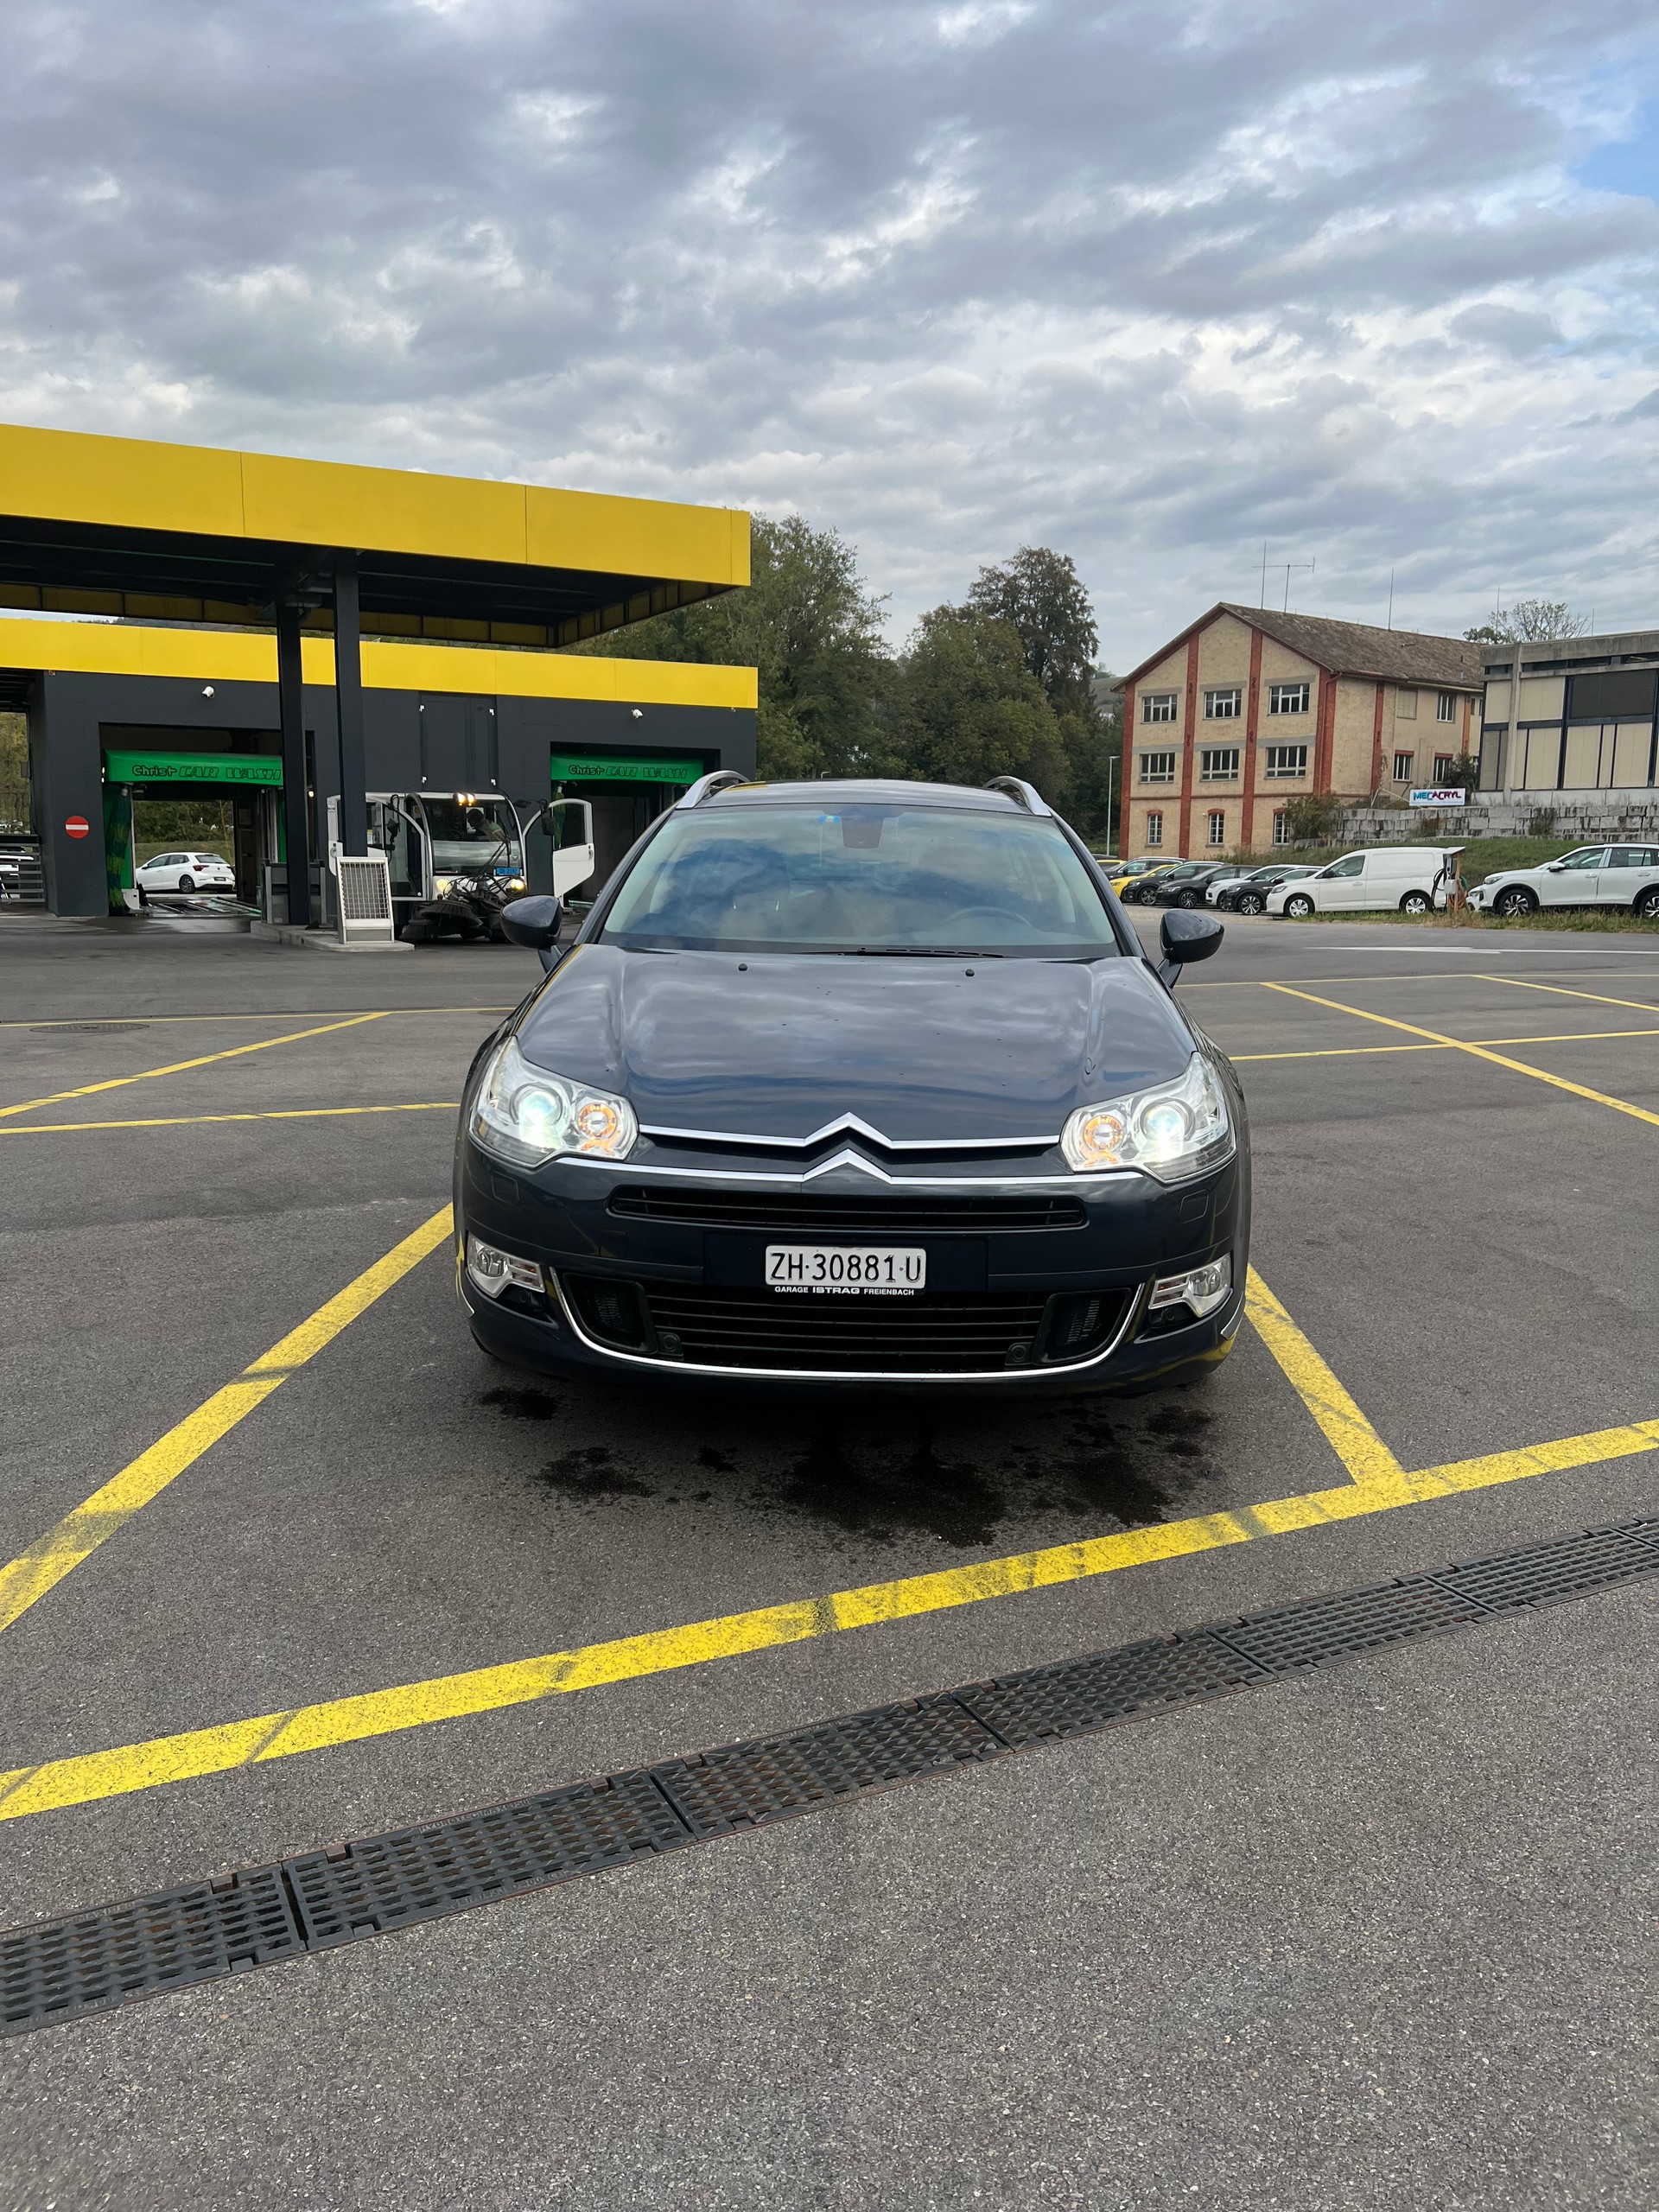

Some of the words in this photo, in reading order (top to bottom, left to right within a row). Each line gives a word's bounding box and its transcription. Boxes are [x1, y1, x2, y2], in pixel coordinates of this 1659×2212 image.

[132, 765, 177, 777] Christ
[179, 766, 219, 778] CAR
[226, 767, 282, 780] WASH
[569, 765, 604, 776] Christ
[606, 766, 638, 778] CAR
[643, 767, 688, 779] WASH
[1414, 791, 1461, 801] MECACRYL
[812, 1286, 860, 1294] ISTRAG
